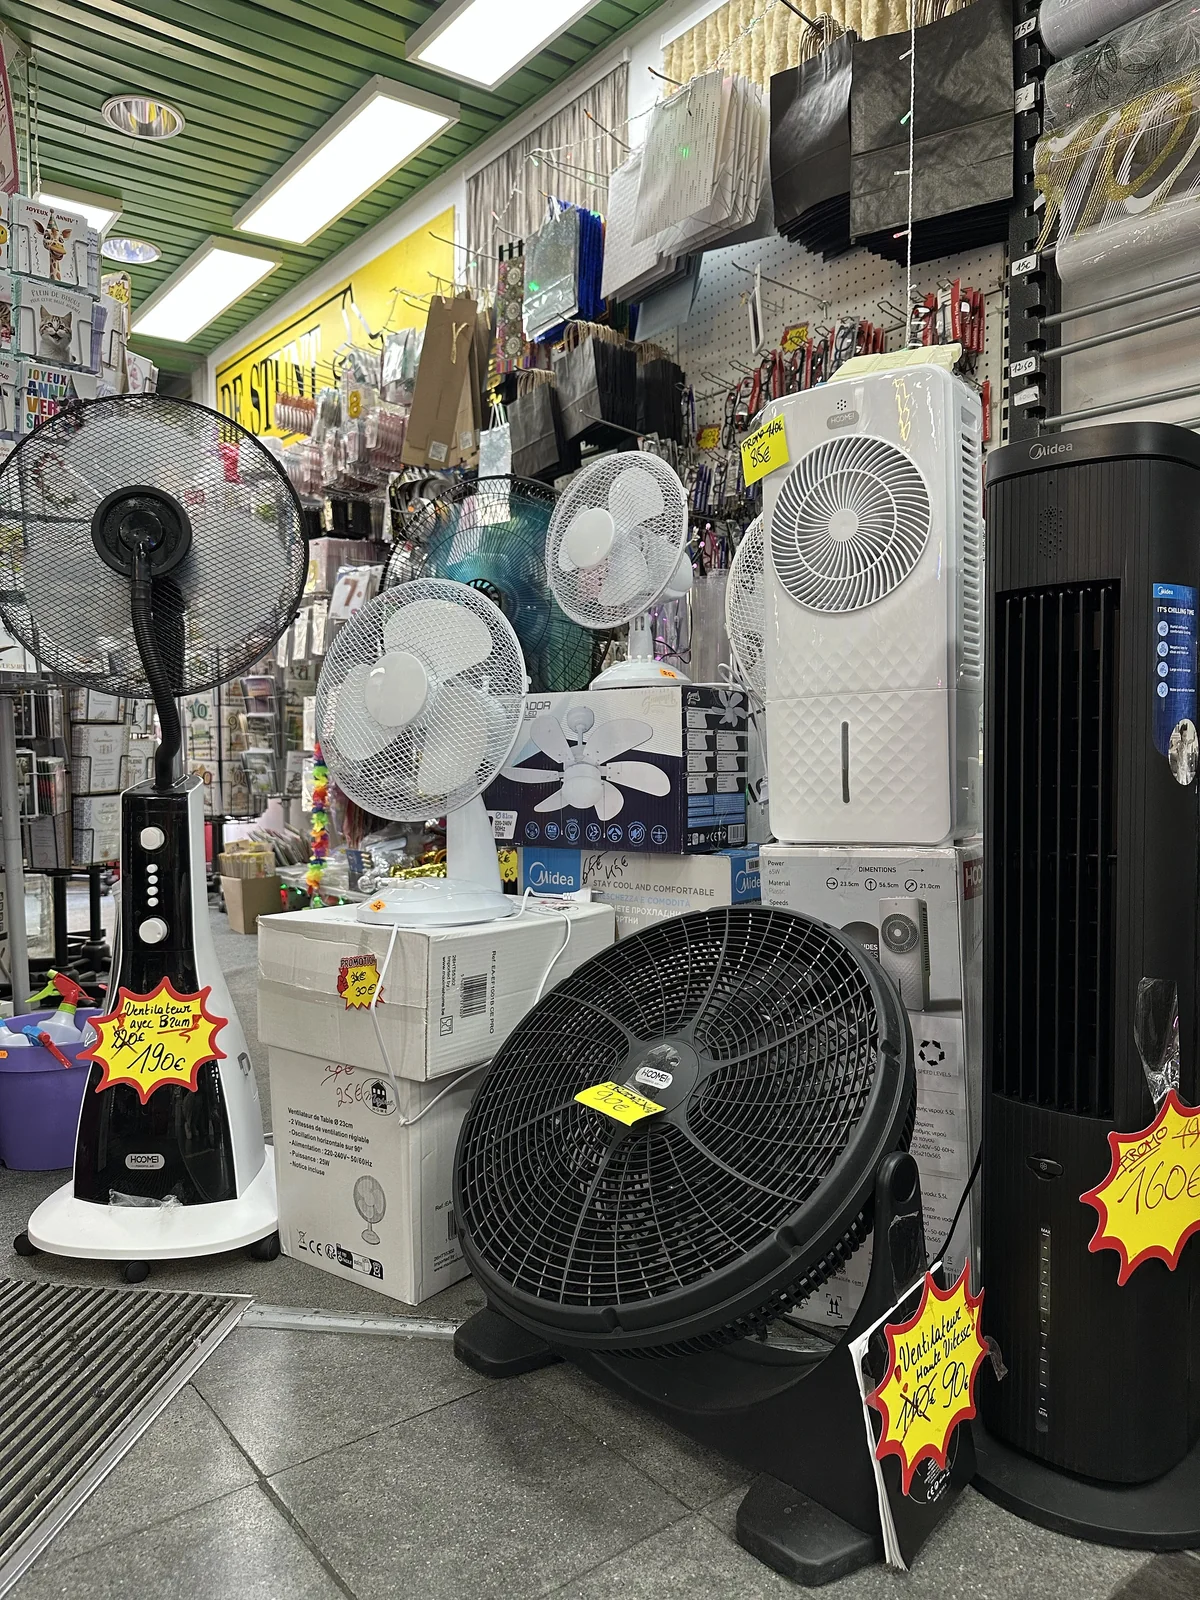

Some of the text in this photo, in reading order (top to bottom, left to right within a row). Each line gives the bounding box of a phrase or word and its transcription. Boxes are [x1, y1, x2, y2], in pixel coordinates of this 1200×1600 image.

[25, 205, 49, 216] JOYEUX
[27, 368, 67, 386] JOYEUX
[26, 396, 59, 416] VER
[750, 441, 771, 468] 85€
[1029, 442, 1073, 460] Midea
[529, 861, 574, 886] Midea
[858, 866, 897, 874] DIMENTIONS
[593, 879, 715, 897] STAY COOL AND COMFORTABLE
[735, 870, 761, 894] Mide
[647, 896, 691, 908] COMODITÀ
[124, 1001, 192, 1016] Ventilateur
[126, 1043, 186, 1074] 190€
[593, 1090, 630, 1113] 90€
[287, 1107, 313, 1119] Ventilateur
[313, 1113, 320, 1121] de
[320, 1115, 334, 1125] Table
[339, 1119, 354, 1129] 23cm
[294, 1119, 315, 1131] Vitesses
[314, 1124, 322, 1132] de
[321, 1127, 349, 1139] ventilation
[348, 1132, 370, 1144] réglable
[1173, 1117, 1200, 1149] 19
[316, 1136, 345, 1149] horizontale
[345, 1143, 354, 1151] sur
[130, 1155, 159, 1164] HOOMEI
[307, 1165, 325, 1176] incluse
[1117, 1161, 1200, 1215] 160€
[899, 1307, 962, 1373] Ventilateur
[916, 1322, 972, 1382] Haute Vitesse
[942, 1361, 969, 1408] 90€
